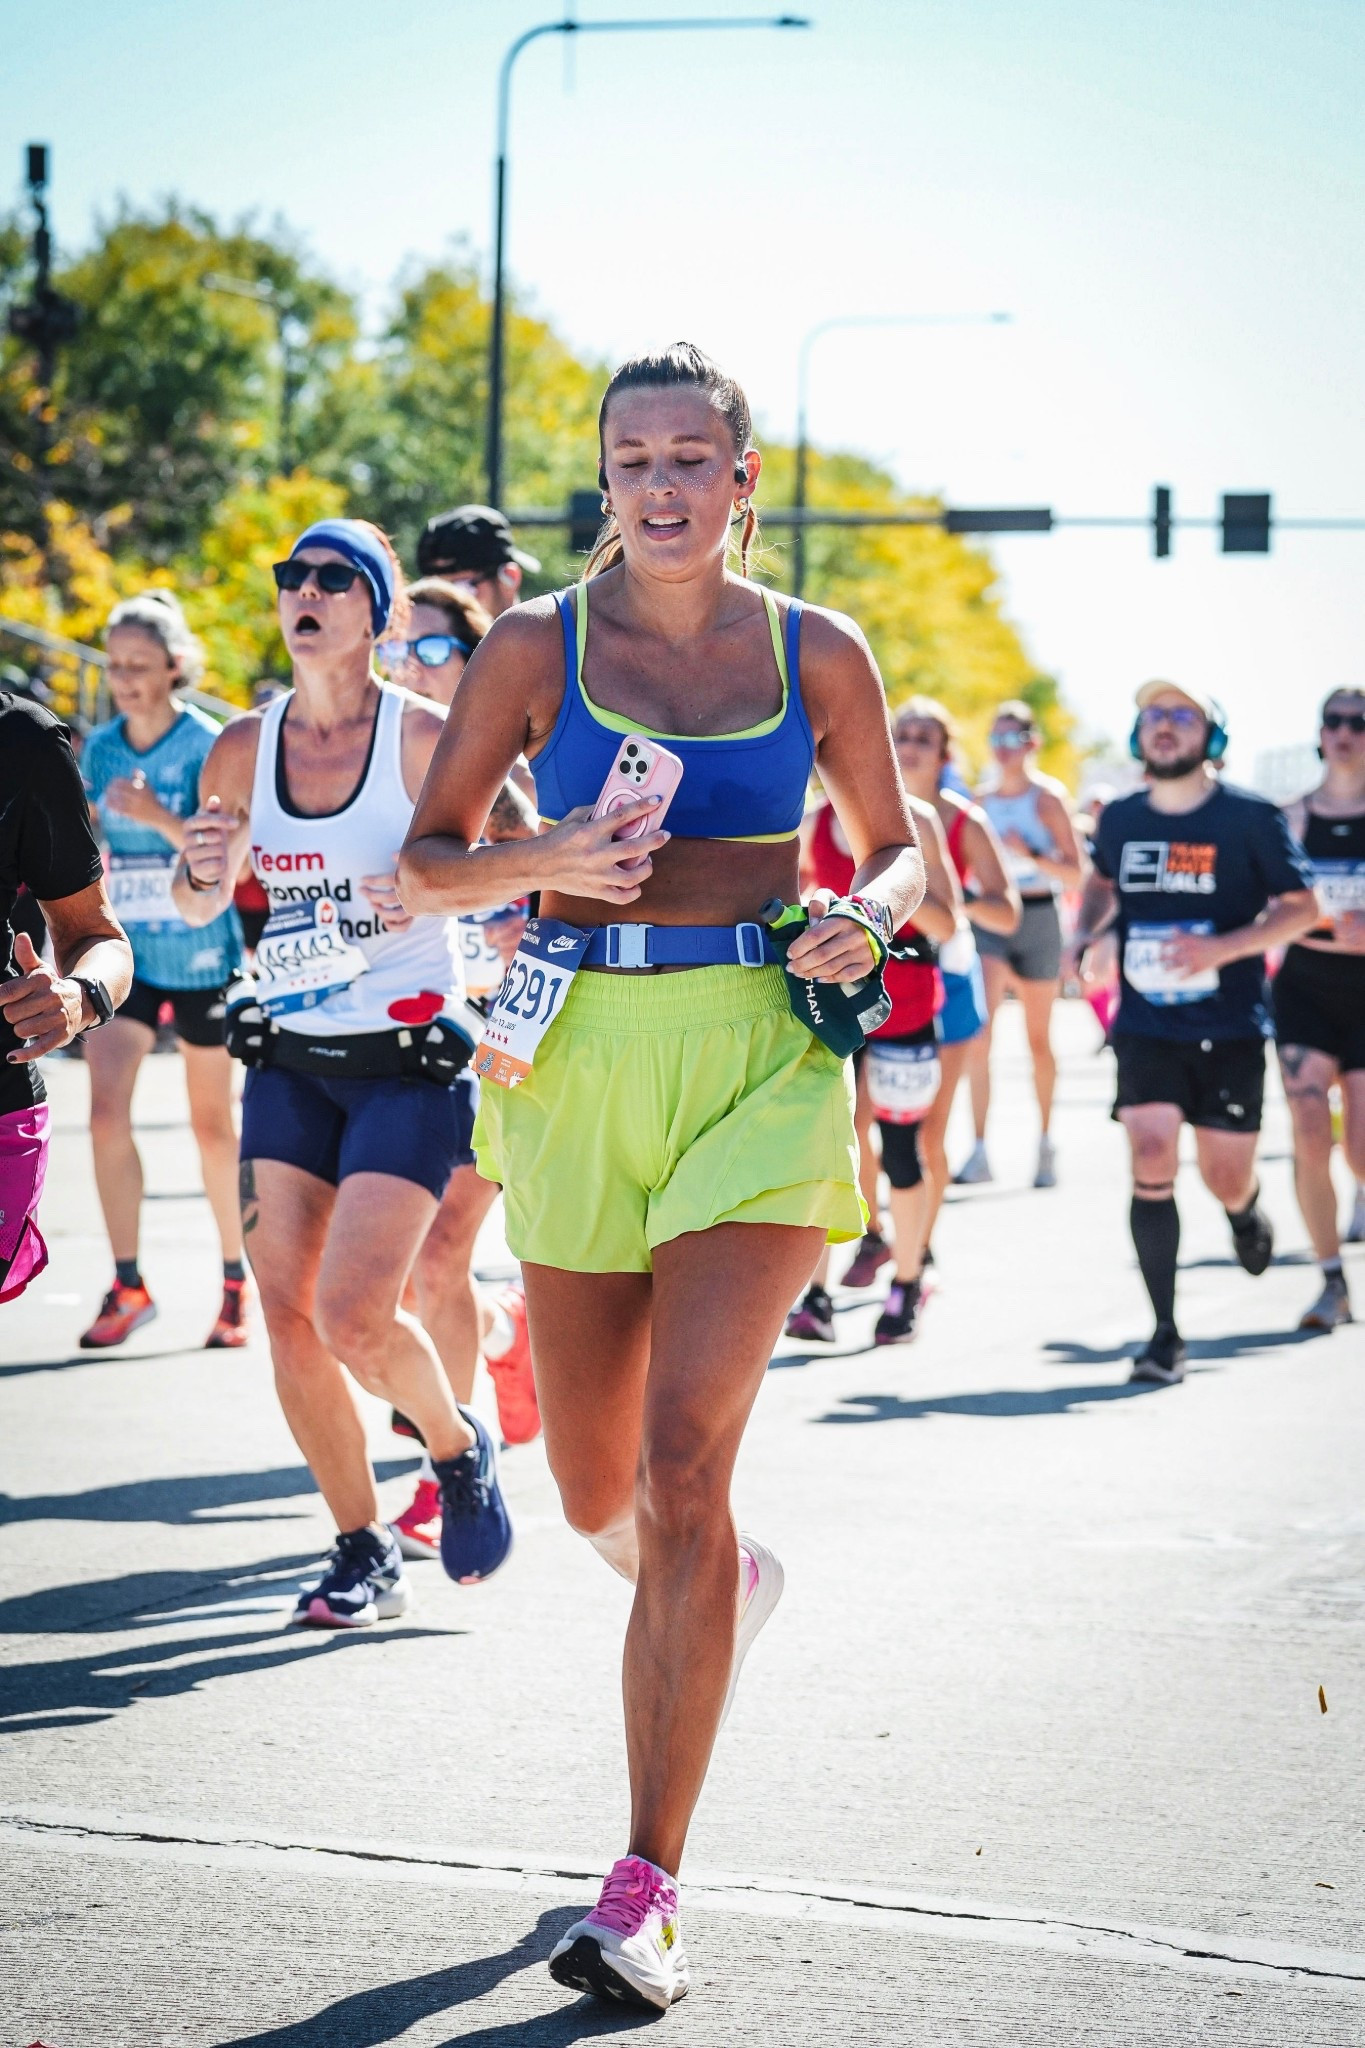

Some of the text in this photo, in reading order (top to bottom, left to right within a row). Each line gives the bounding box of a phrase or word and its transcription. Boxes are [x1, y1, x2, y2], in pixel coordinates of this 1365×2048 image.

[252, 845, 324, 872] Team
[554, 935, 579, 949] RUN
[497, 958, 564, 1025] 6291
[804, 977, 824, 1025] THAN
